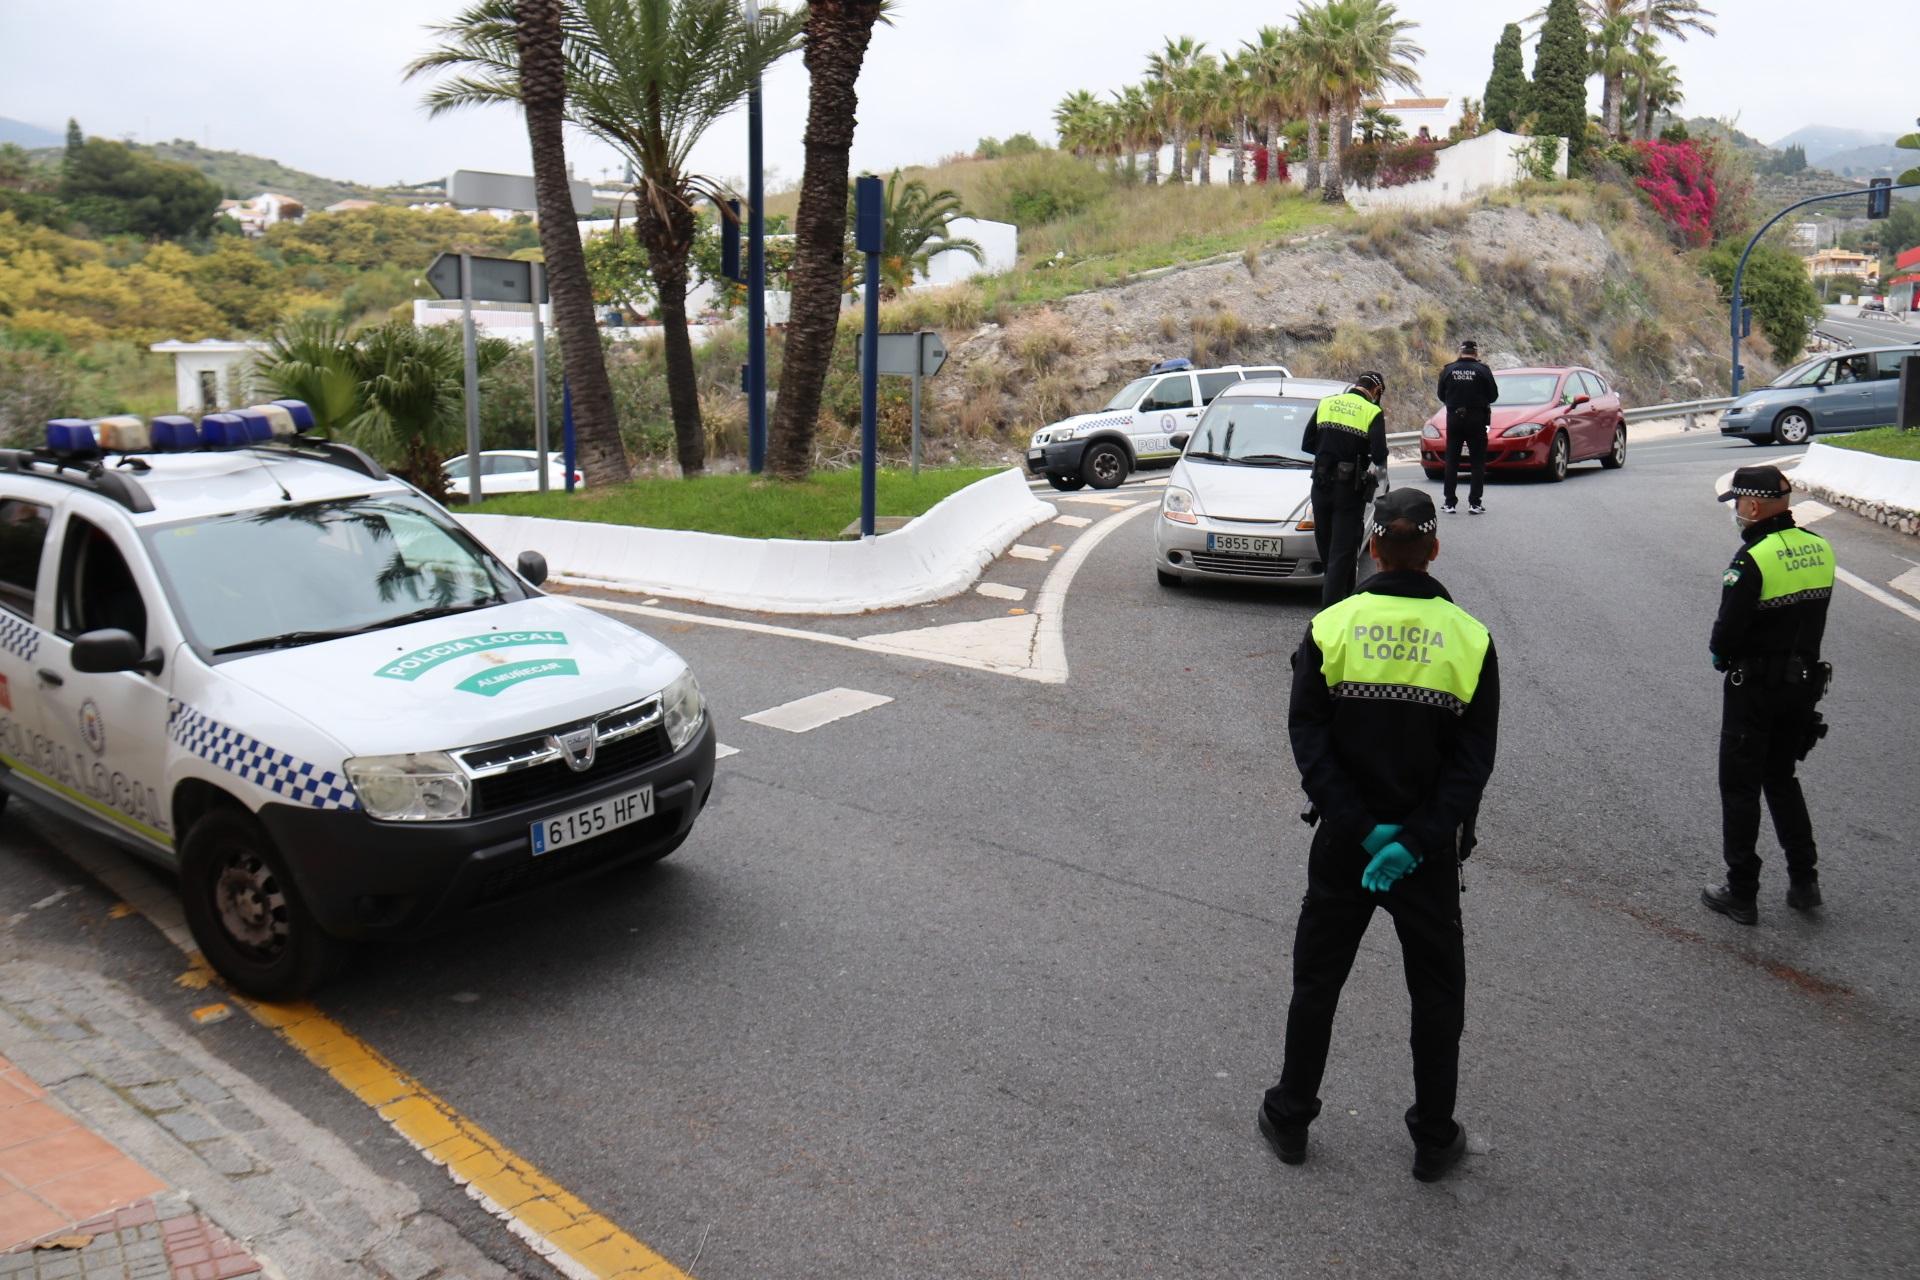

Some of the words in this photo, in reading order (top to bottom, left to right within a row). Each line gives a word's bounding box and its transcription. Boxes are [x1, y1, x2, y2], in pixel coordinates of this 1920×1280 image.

[1329, 405, 1357, 417] LOCAL
[1330, 397, 1362, 411] POLICIA
[1216, 536, 1249, 550] 5855
[1253, 539, 1278, 552] GFX
[1776, 543, 1825, 560] POLICIA
[1785, 555, 1825, 572] LOCAL
[1354, 624, 1445, 648] POLICIA
[385, 641, 474, 677] POLICIA
[473, 631, 563, 647] LOCAL
[1362, 642, 1432, 664] LOCAL
[549, 806, 606, 844] 6155
[613, 789, 651, 824] HFV
